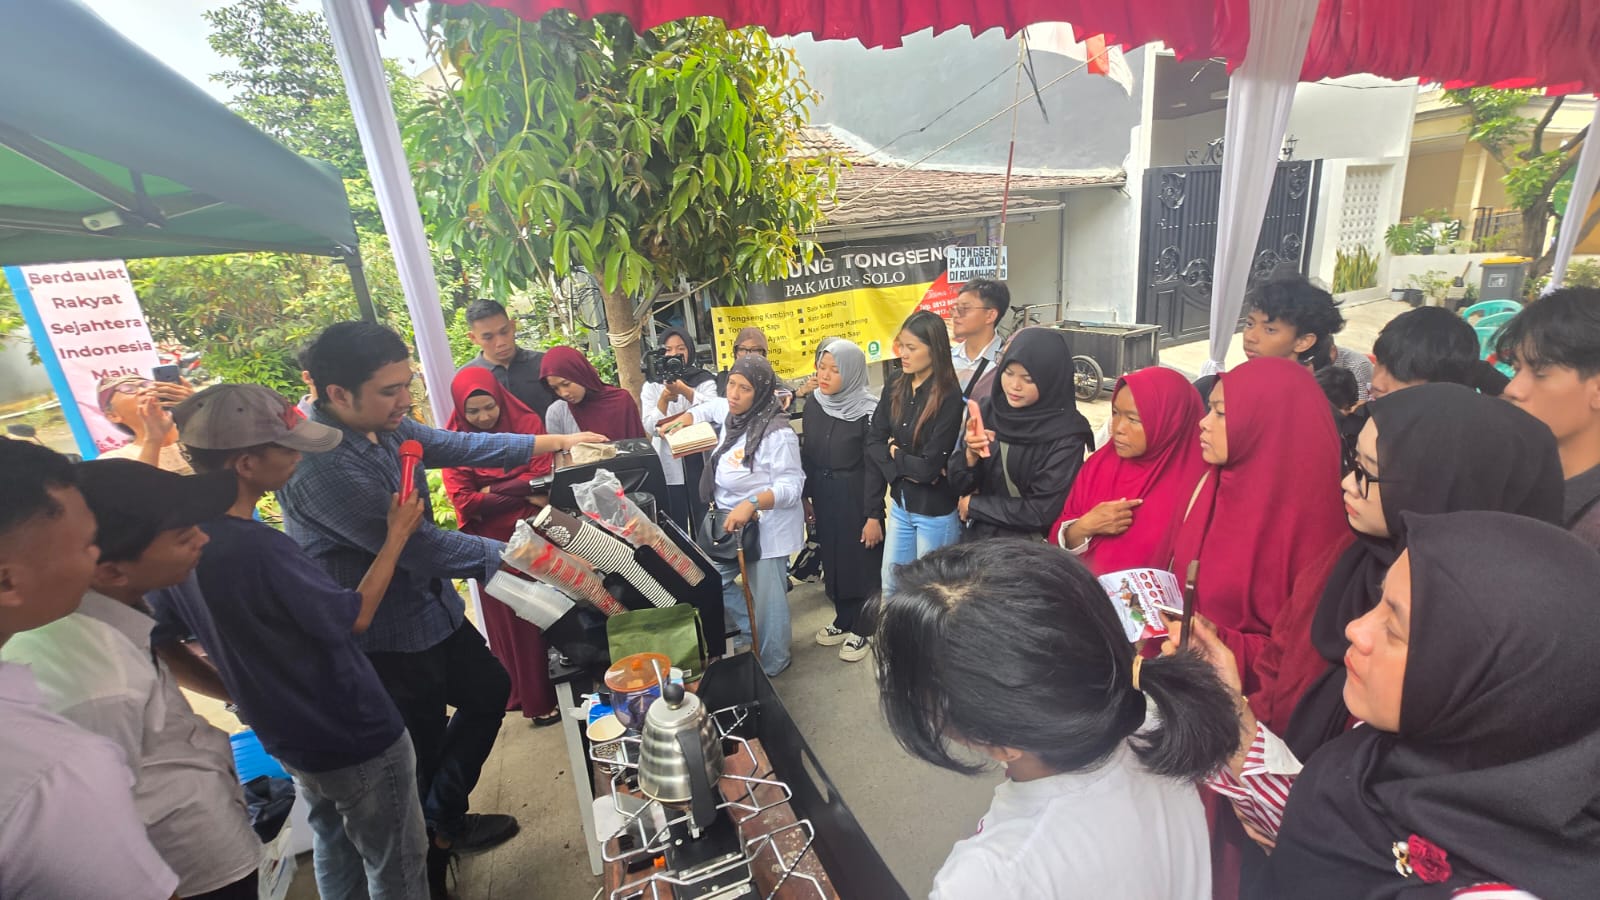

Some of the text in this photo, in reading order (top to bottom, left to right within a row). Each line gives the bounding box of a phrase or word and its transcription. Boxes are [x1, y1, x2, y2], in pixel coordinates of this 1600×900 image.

[950, 258, 966, 268] PAK
[987, 255, 1006, 267] BUA
[28, 268, 126, 285] Berdaulat
[785, 281, 816, 298] PAK
[818, 275, 853, 292] MUR
[862, 271, 905, 285] SOLO
[52, 294, 123, 309] Rakyat
[51, 317, 142, 335] Sejahtera
[727, 314, 764, 323] Tongseng
[59, 340, 152, 359] Indonesia
